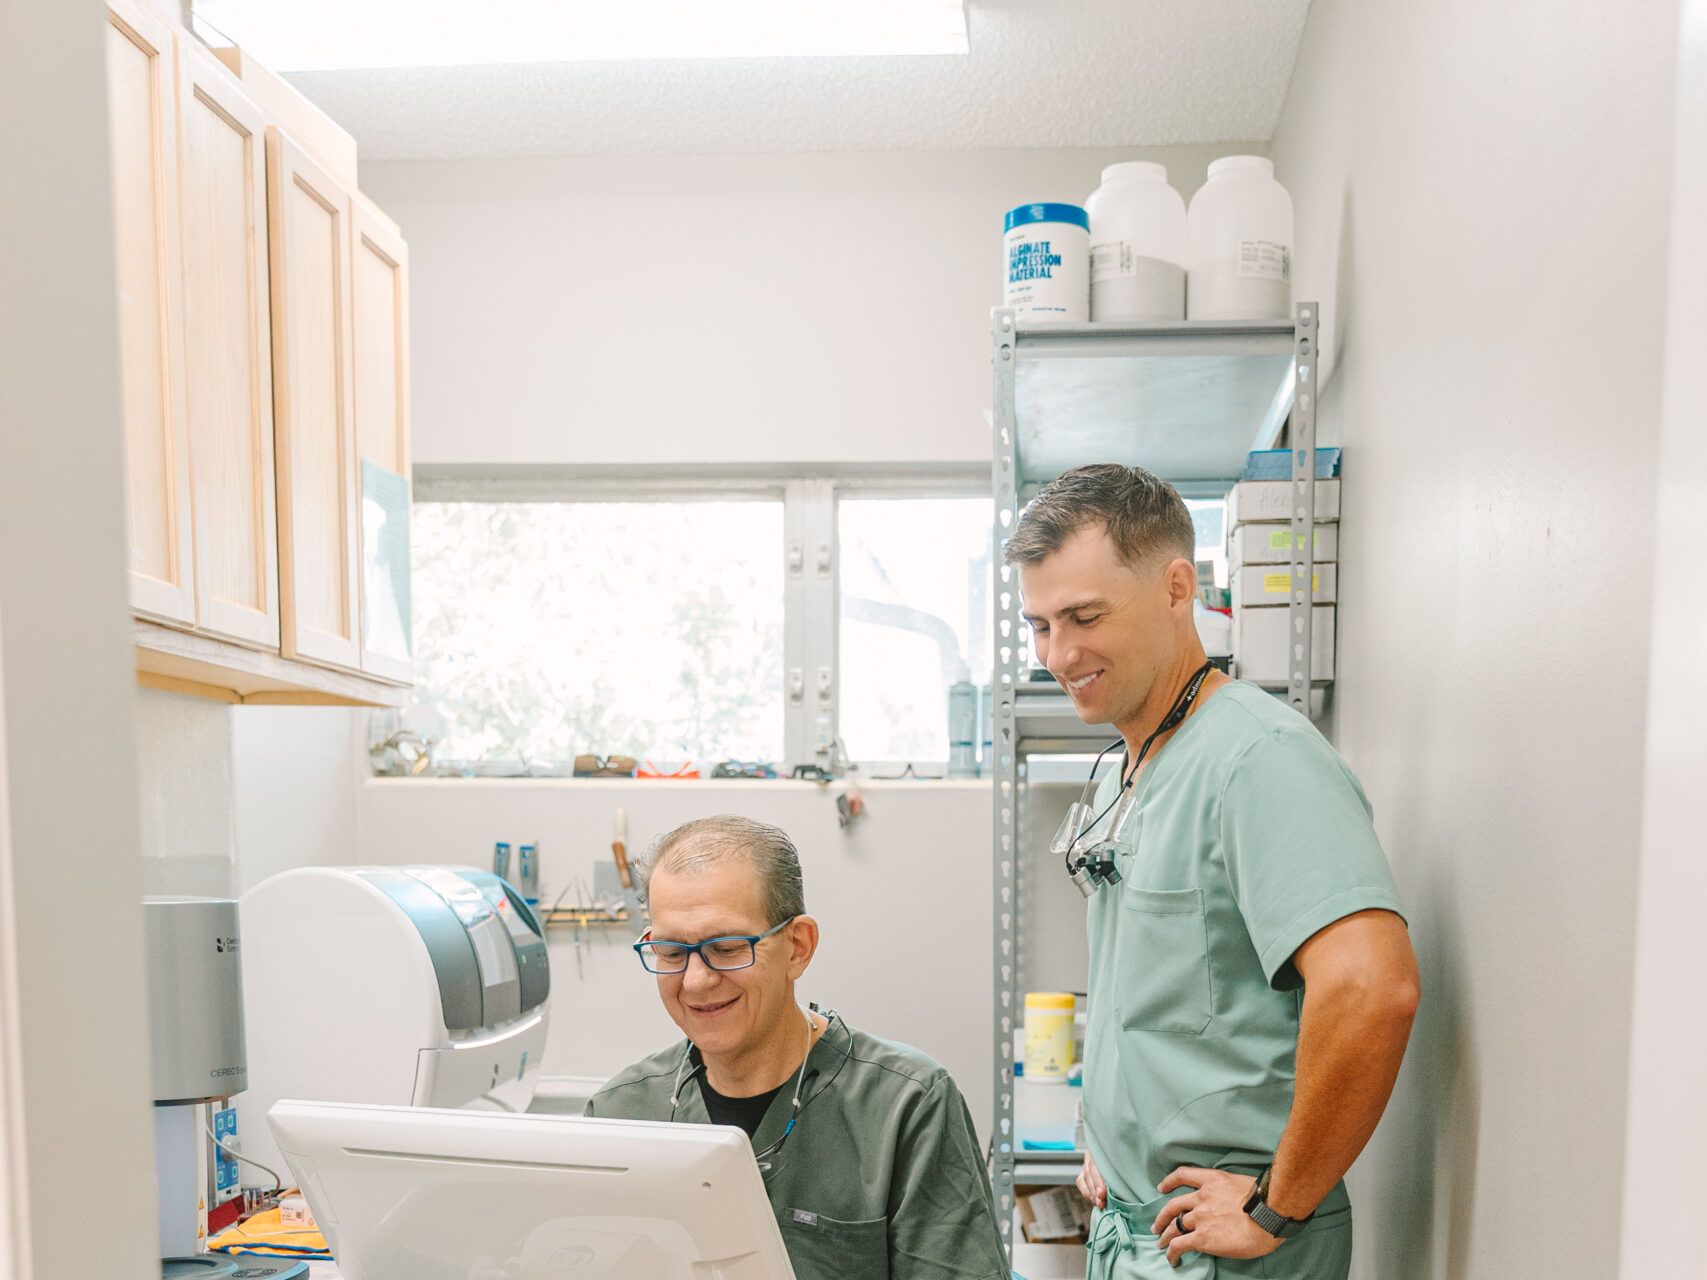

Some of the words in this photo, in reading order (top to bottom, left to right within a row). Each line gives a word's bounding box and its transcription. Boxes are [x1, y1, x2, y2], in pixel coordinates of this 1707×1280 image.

[1010, 241, 1050, 257] ALGINATE
[1010, 254, 1062, 270] IMPRESSION
[1009, 266, 1052, 282] MATERIAL
[210, 1067, 235, 1078] CEREC
